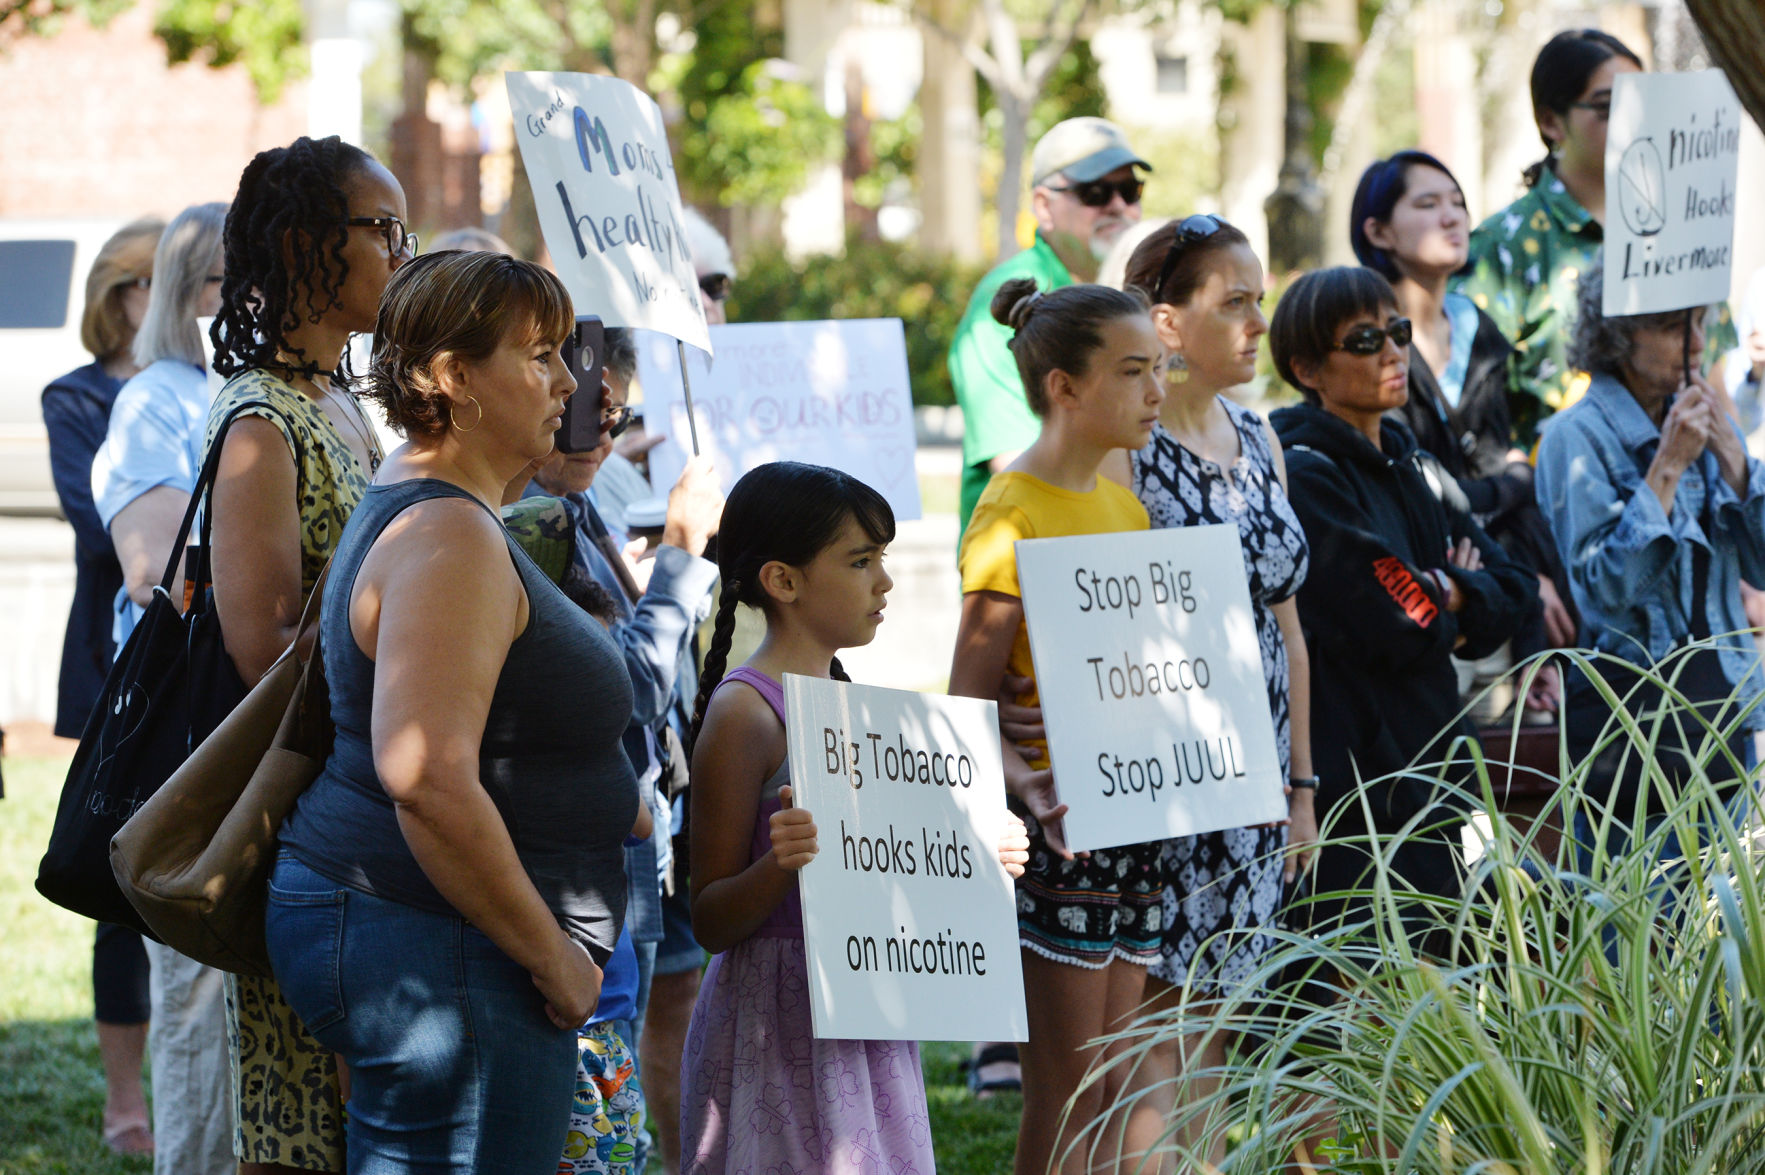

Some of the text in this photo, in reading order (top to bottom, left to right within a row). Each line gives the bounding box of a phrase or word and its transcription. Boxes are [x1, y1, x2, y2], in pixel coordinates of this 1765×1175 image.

[526, 90, 564, 138] Grand
[573, 105, 663, 181] Moms
[1669, 106, 1740, 170] nicotin
[1622, 242, 1729, 281] Livermore
[836, 388, 902, 427] KIDS
[1075, 560, 1197, 619] Stop Big
[1087, 652, 1210, 701] Tobacco
[823, 727, 972, 789] Big Tobacco
[1098, 736, 1246, 802] Stop JUUL
[840, 819, 973, 879] hooks kids
[846, 926, 987, 976] on nicotine
